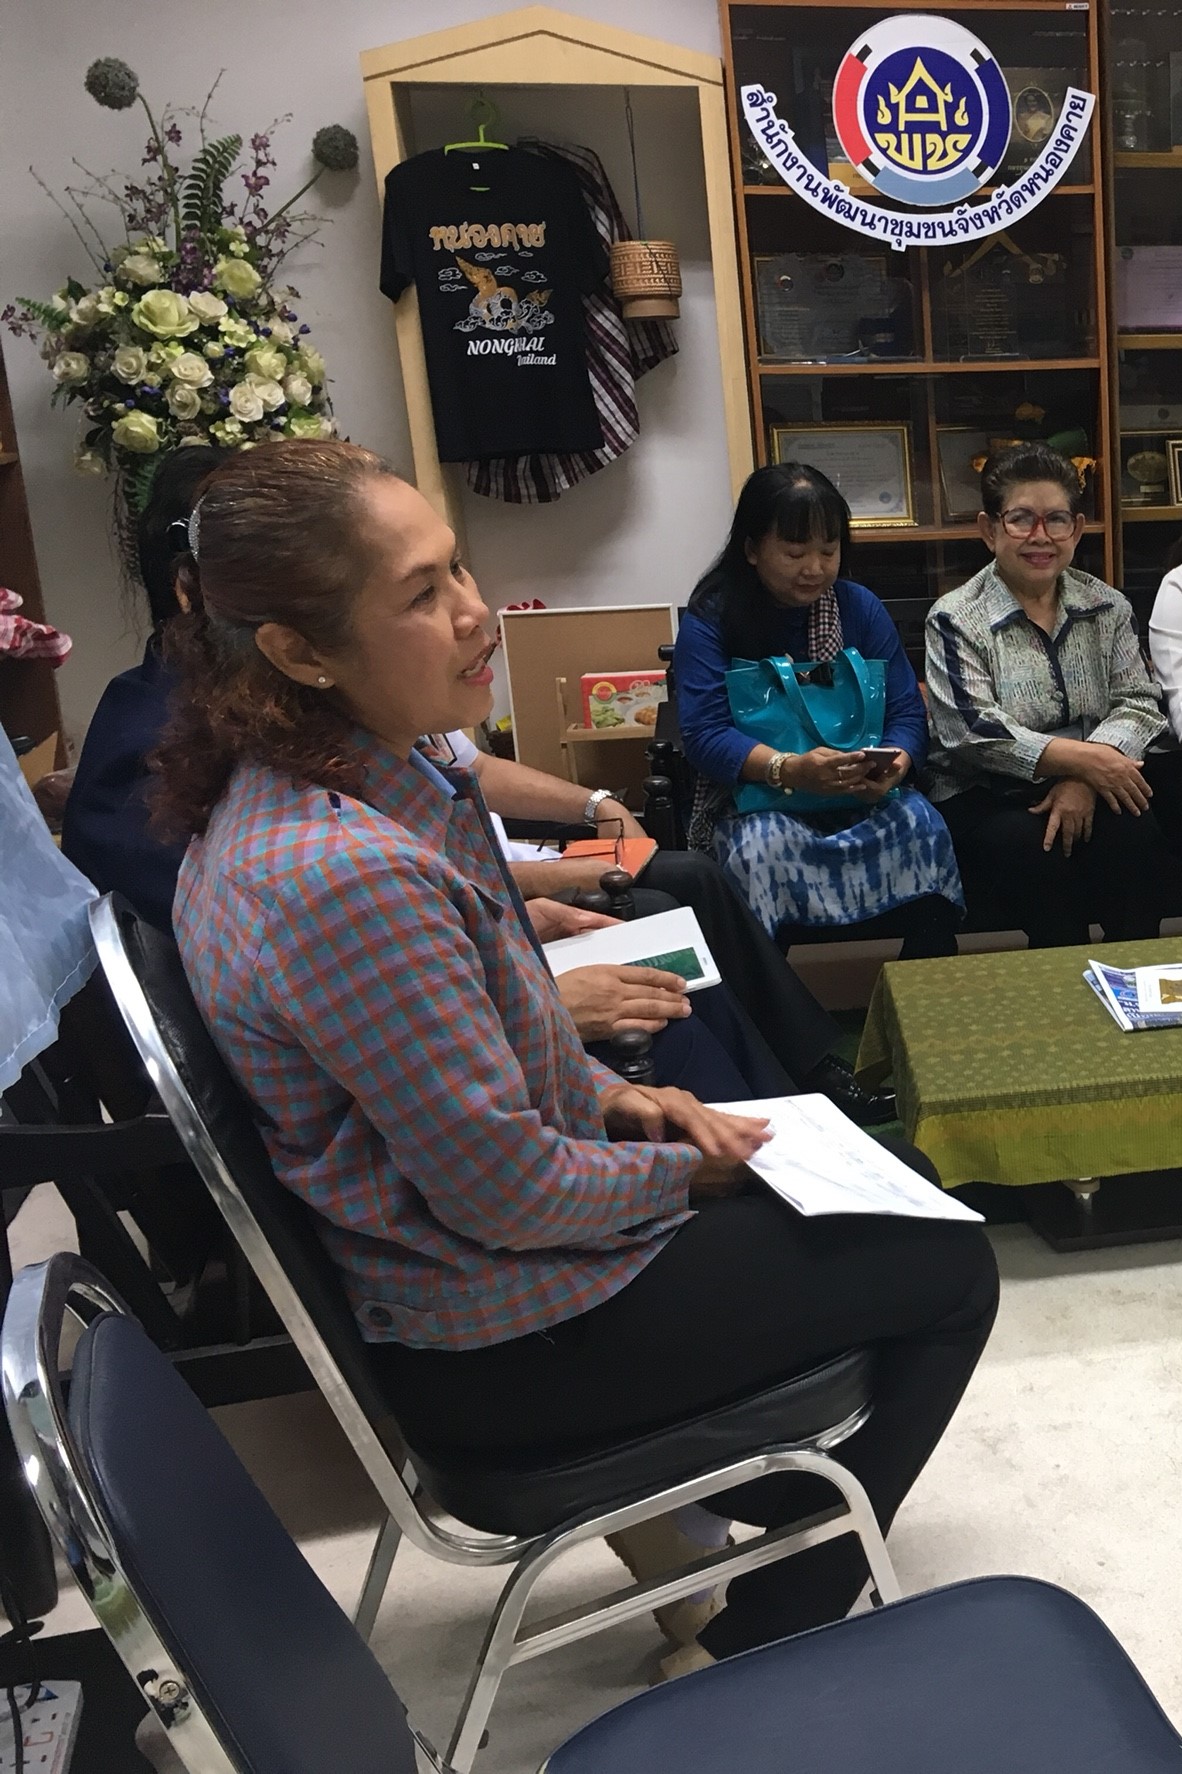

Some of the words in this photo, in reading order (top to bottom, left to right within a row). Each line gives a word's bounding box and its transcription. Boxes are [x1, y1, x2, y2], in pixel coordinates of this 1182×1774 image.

[745, 88, 1088, 248] สำนักงานพัฒนาชุมชนจังหวัดหนองคาย
